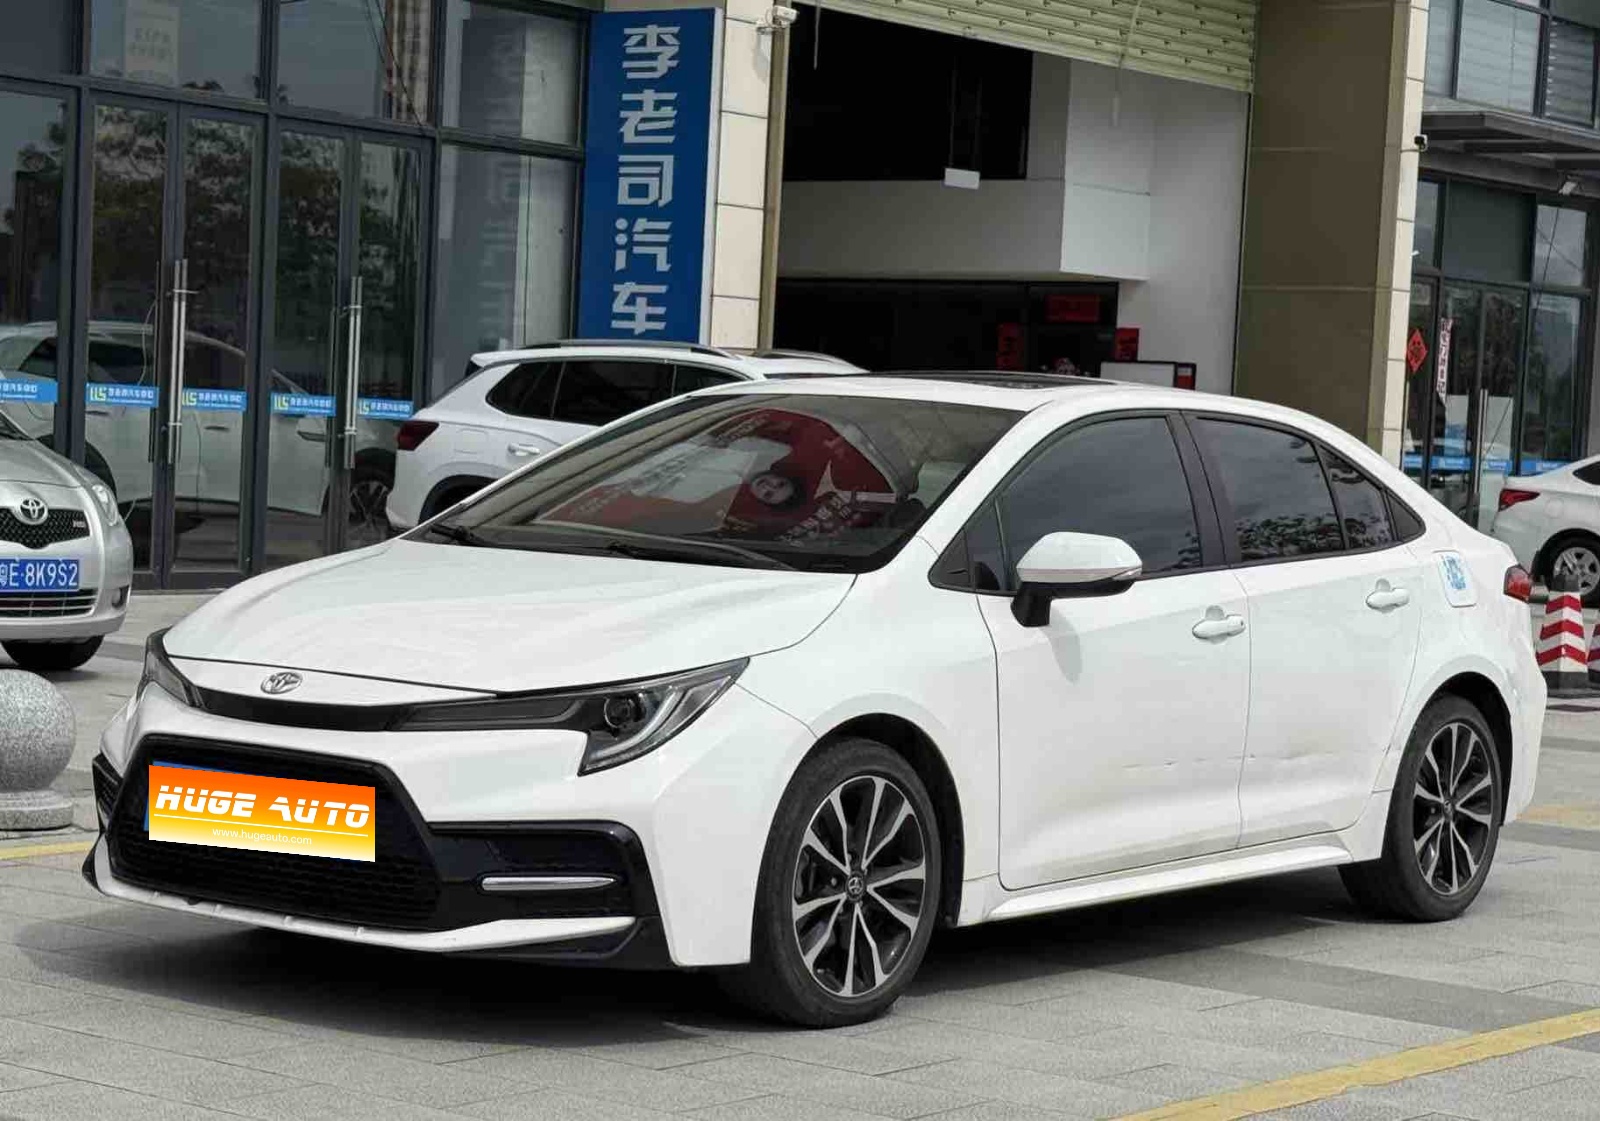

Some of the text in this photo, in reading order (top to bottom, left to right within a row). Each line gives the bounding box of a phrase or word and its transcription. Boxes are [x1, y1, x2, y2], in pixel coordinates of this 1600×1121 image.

[610, 24, 681, 336] 李老司汽车
